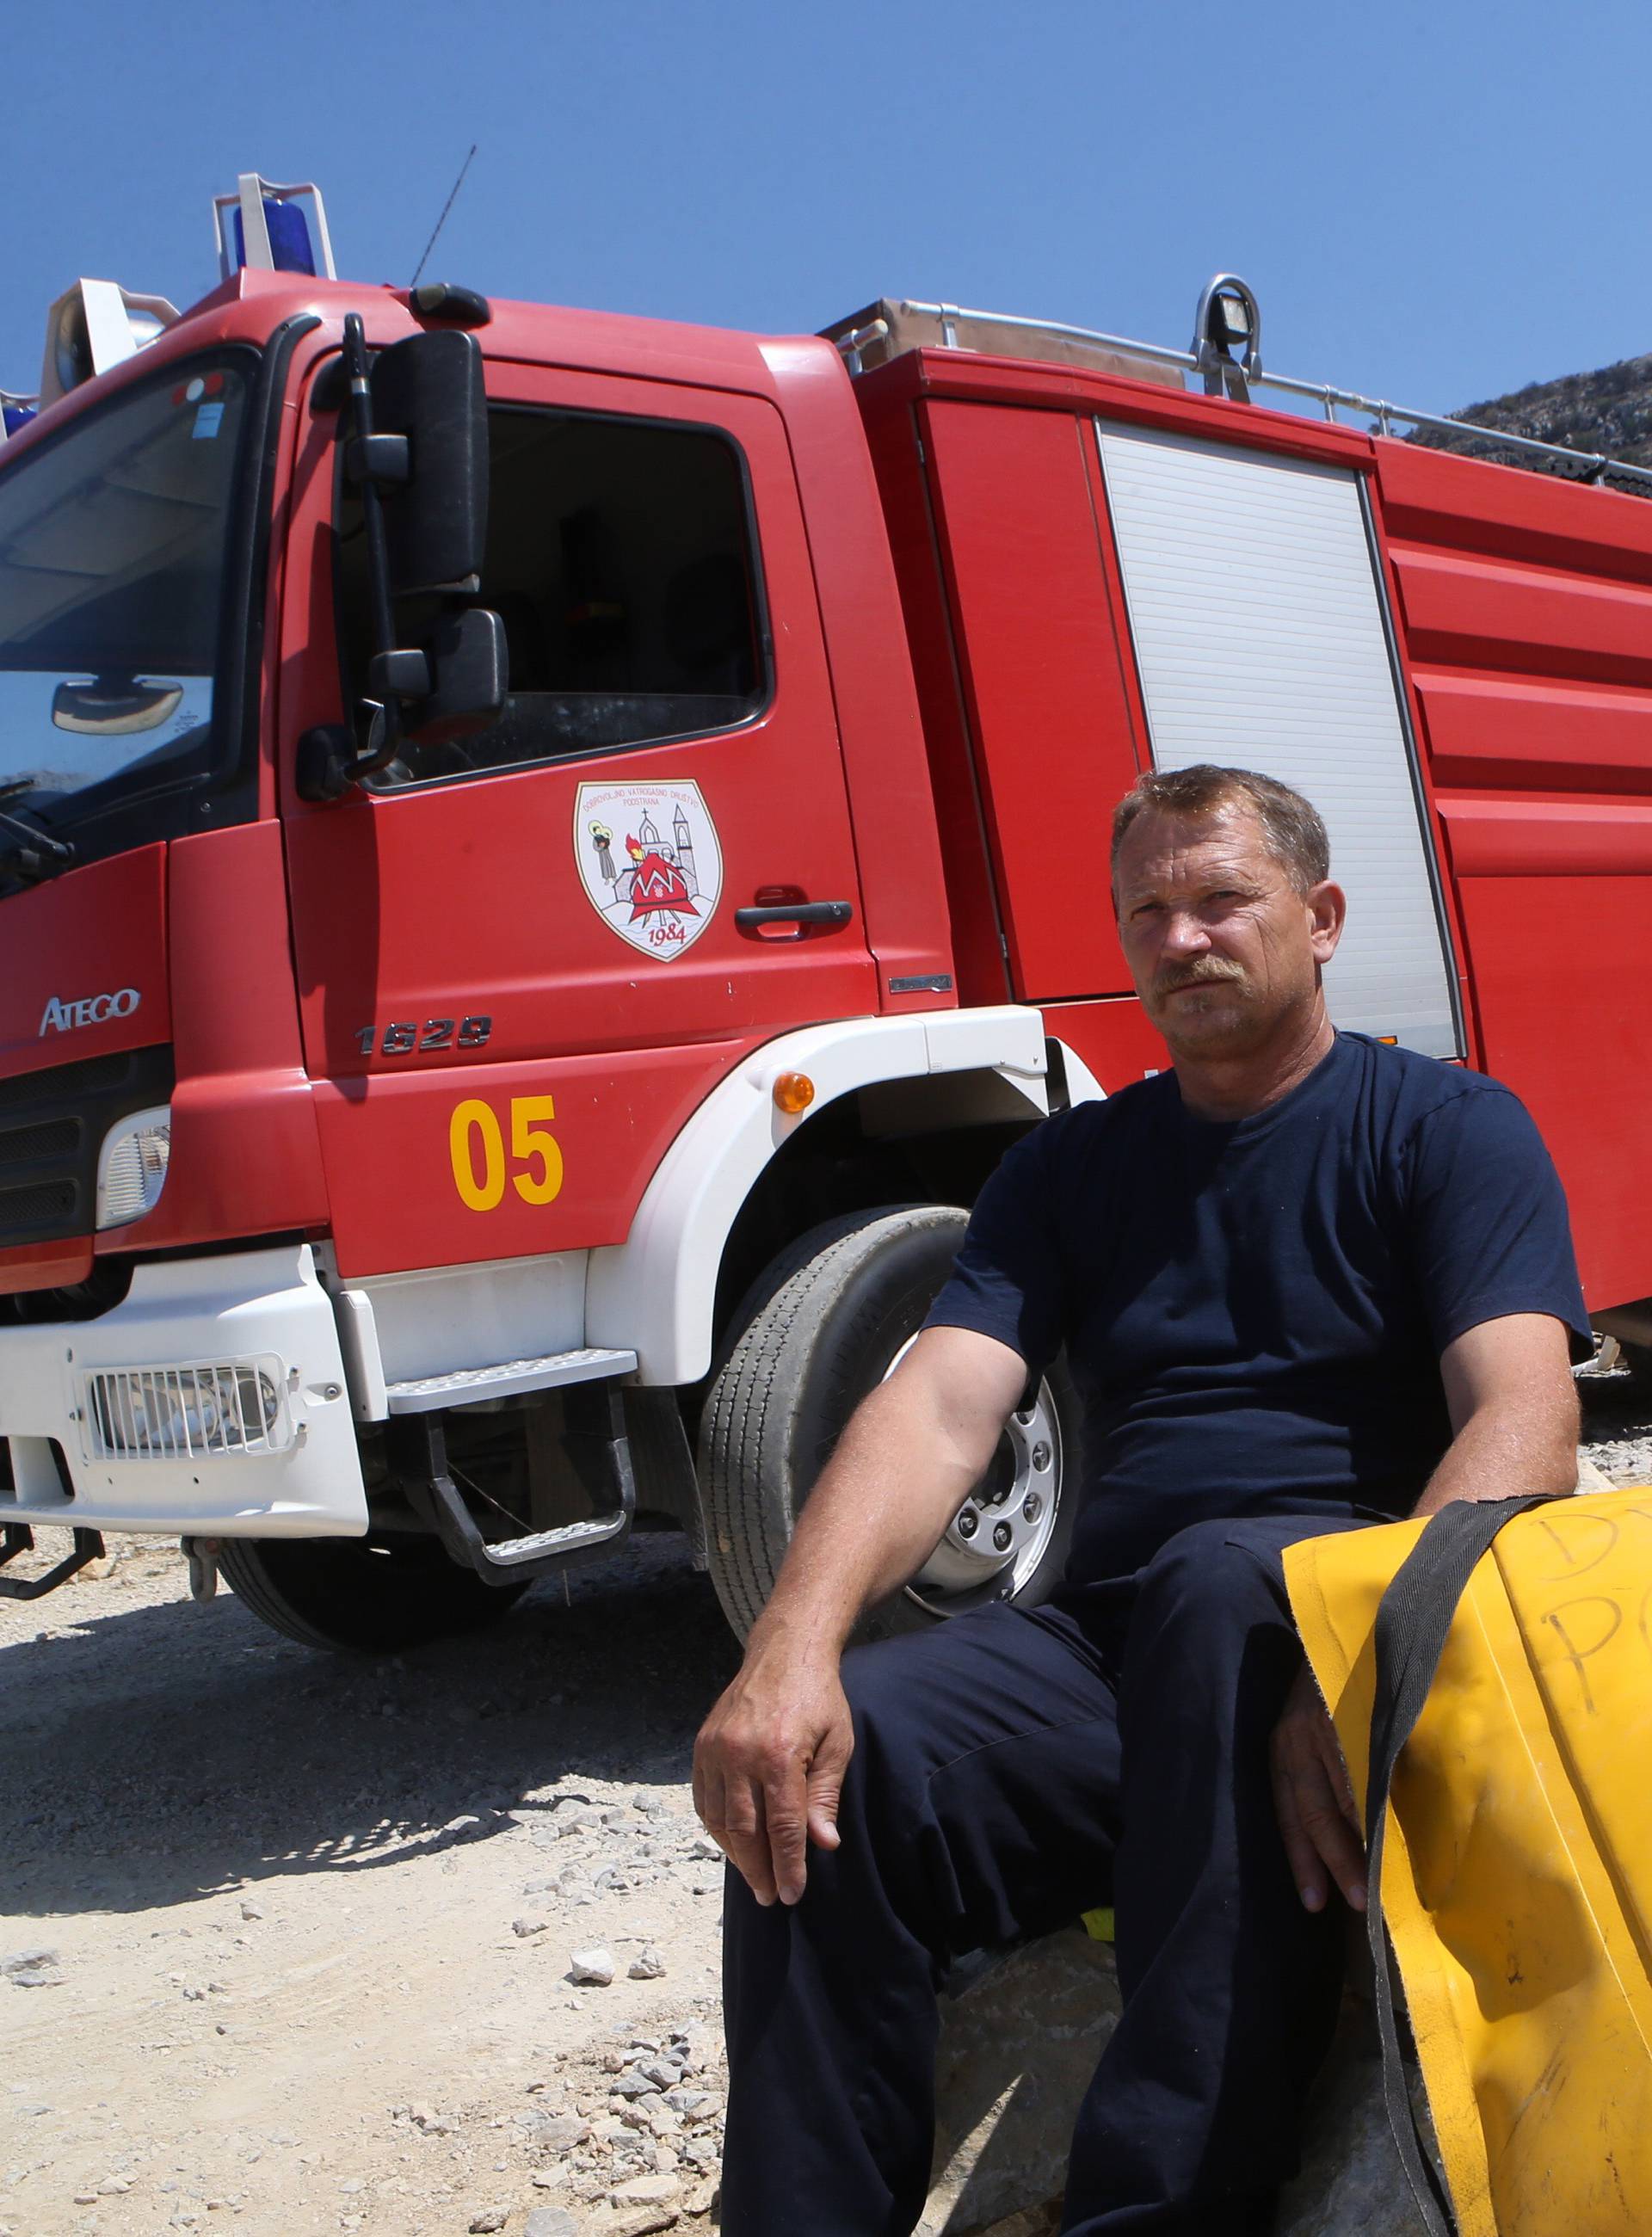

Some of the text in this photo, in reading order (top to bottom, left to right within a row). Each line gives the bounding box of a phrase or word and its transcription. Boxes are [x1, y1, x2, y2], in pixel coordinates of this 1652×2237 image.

[648, 922, 687, 946] 1984
[354, 1015, 492, 1055] 1629
[450, 1094, 564, 1211] 05
[1529, 1508, 1652, 1581] D
